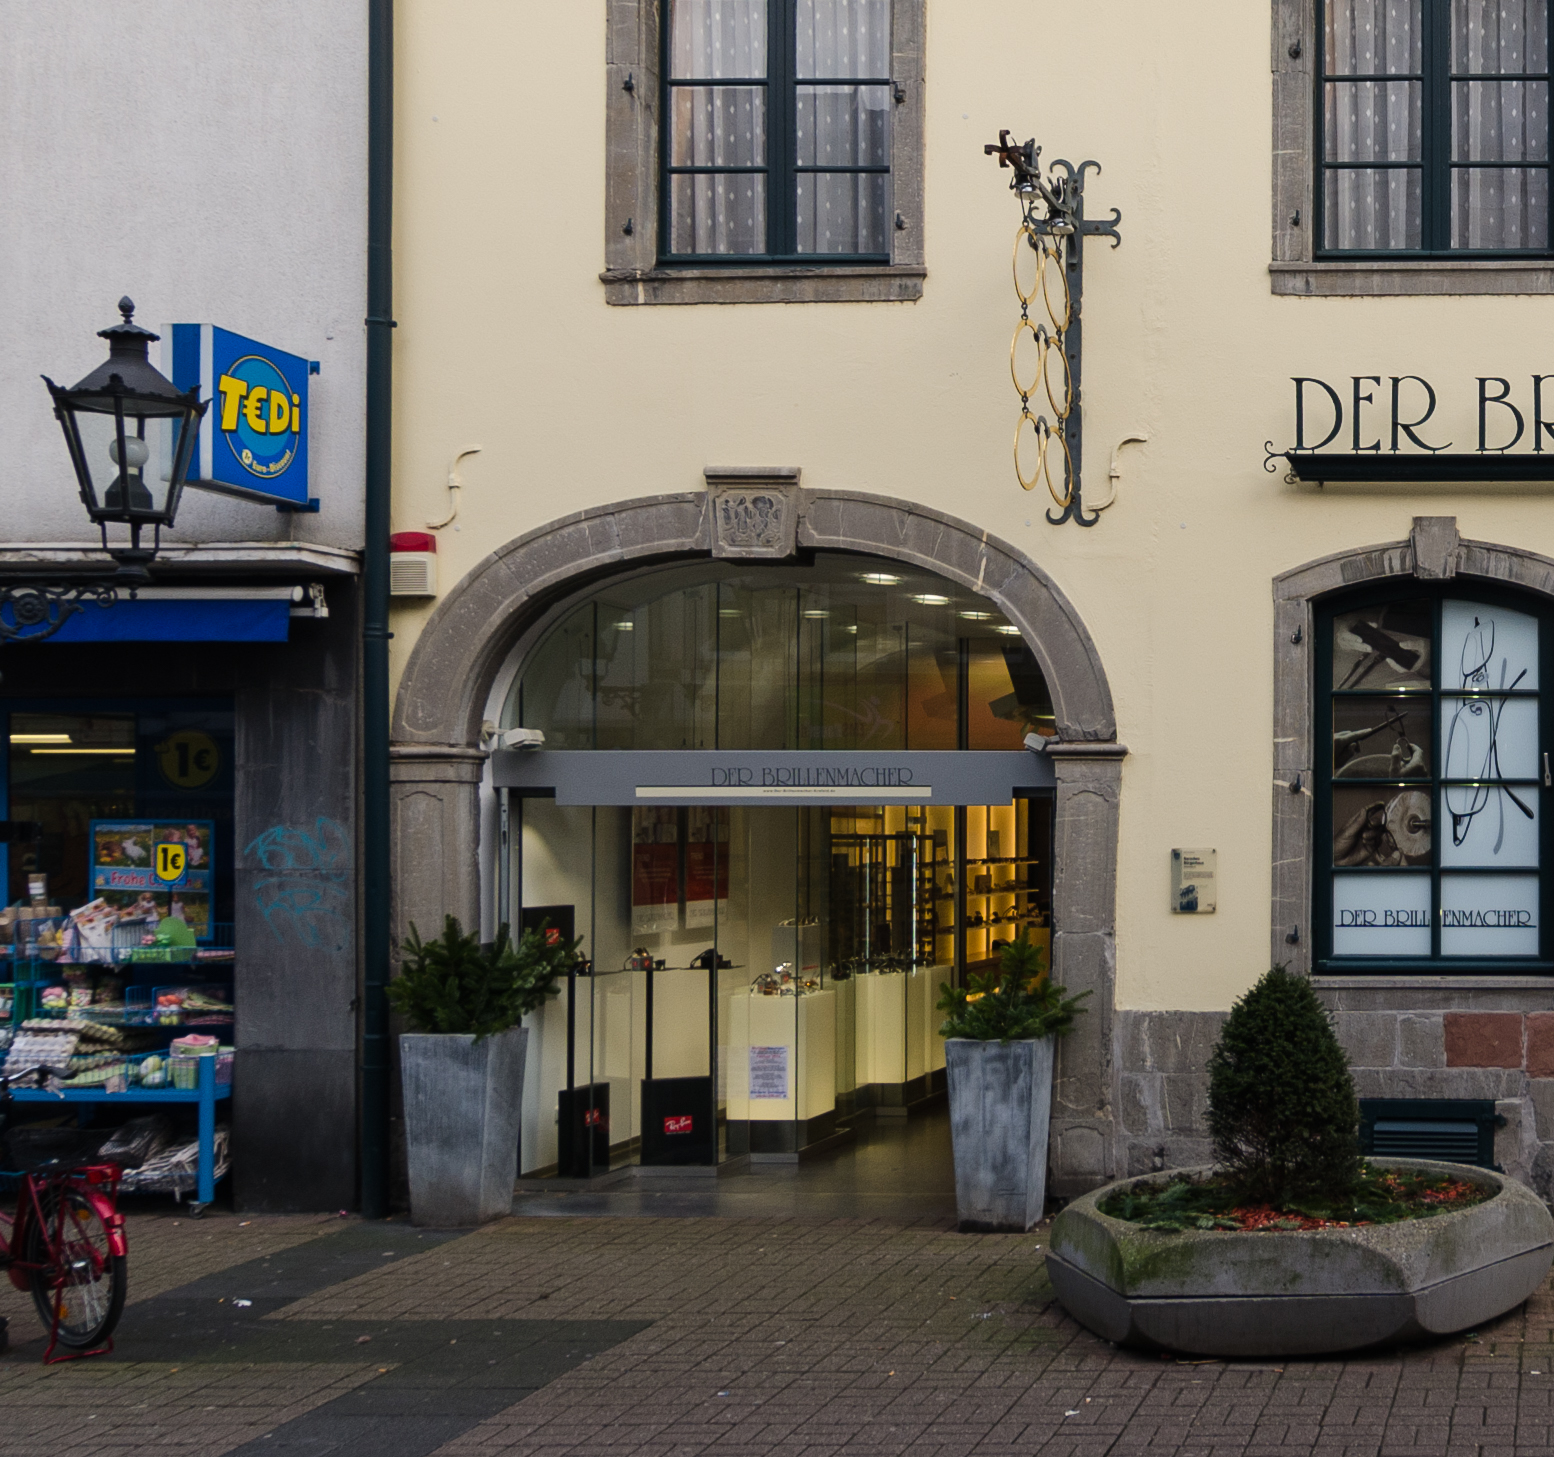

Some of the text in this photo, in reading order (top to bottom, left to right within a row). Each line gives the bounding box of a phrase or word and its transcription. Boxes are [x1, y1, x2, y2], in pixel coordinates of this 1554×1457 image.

[1289, 376, 1453, 452] DER
[174, 741, 211, 779] 1€
[711, 767, 914, 786] DER BRILLENMACHER
[161, 847, 182, 872] 1€
[111, 870, 146, 886] Frohe
[1339, 909, 1378, 926] DER
